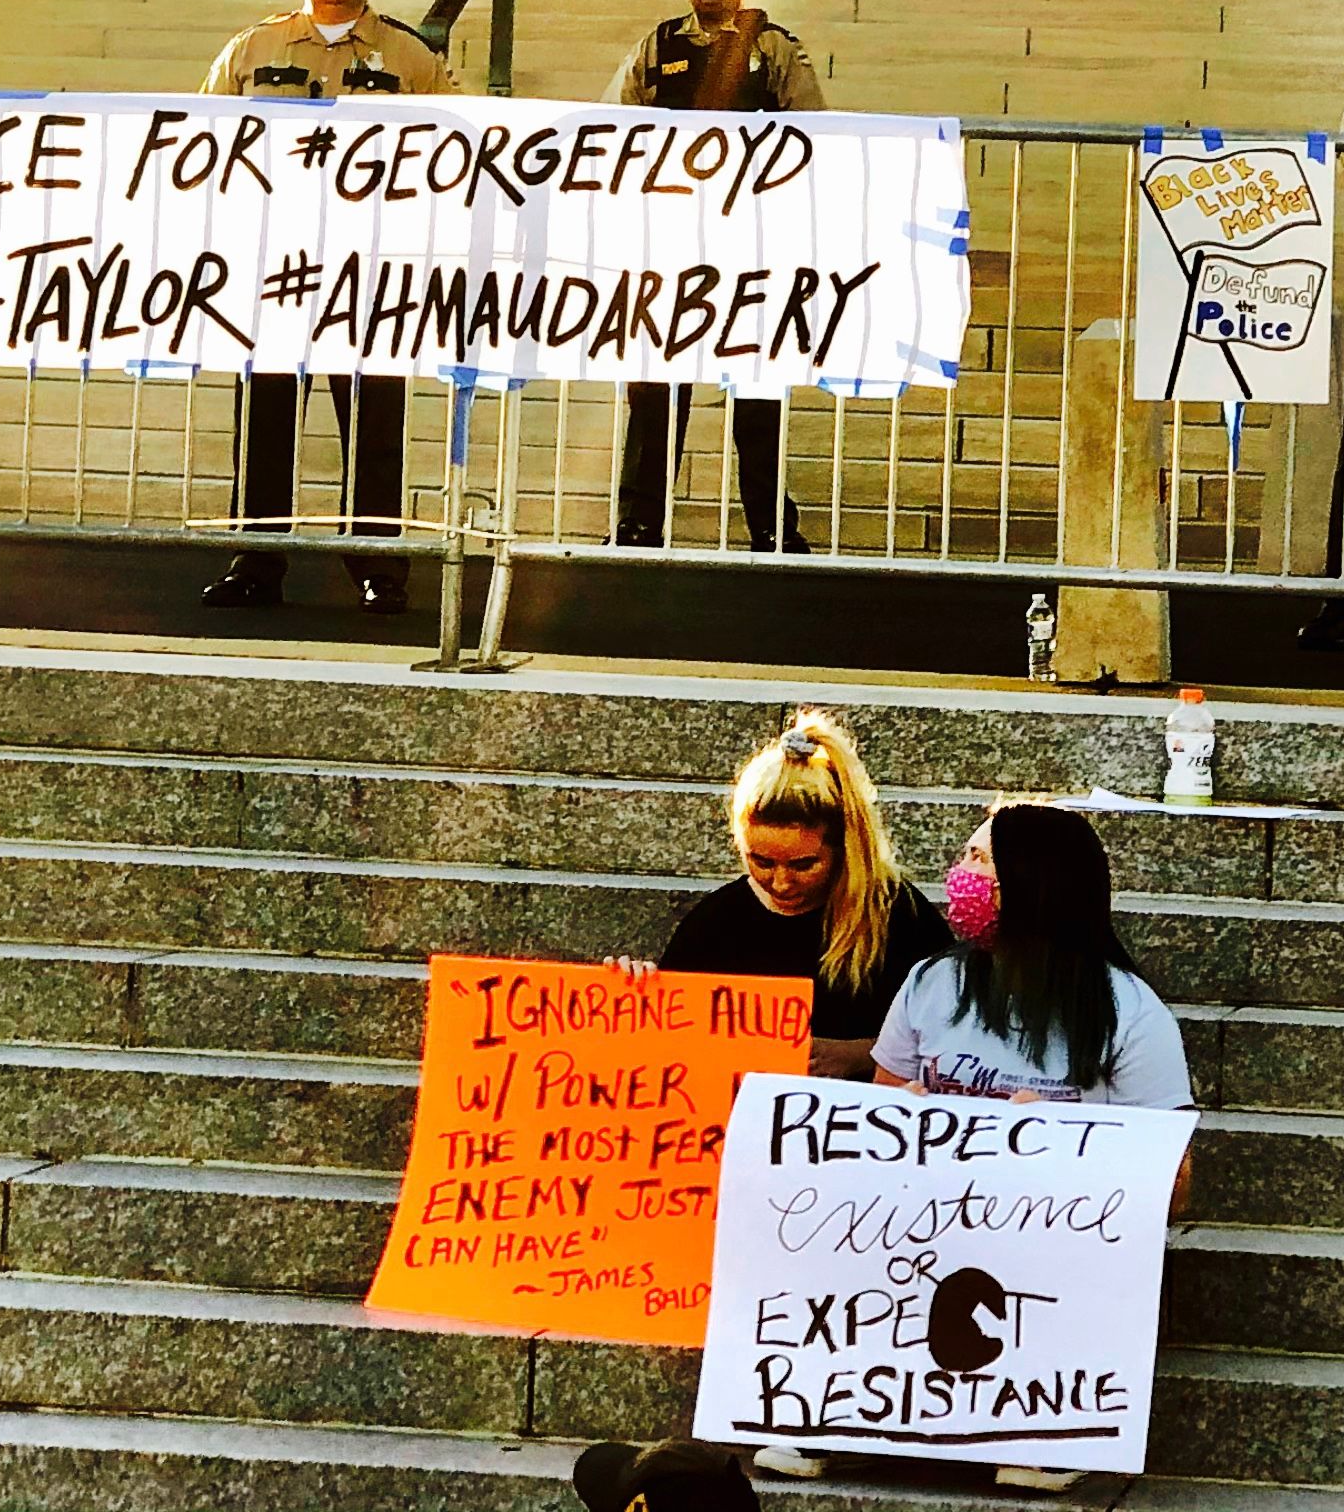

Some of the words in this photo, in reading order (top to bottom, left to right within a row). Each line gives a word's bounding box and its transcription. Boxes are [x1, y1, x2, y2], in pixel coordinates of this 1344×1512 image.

[125, 111, 273, 201] FOR
[286, 122, 813, 217] #GEORGEFLOYD
[1149, 157, 1255, 211] Black
[1195, 169, 1280, 218] Lives
[1219, 184, 1313, 241] Matter
[260, 248, 881, 367] #AHMAUDARBERY
[1202, 264, 1315, 310] Defund
[1235, 299, 1257, 314] the
[1196, 300, 1293, 342] Police
[533, 1049, 698, 1115] POWER
[439, 1129, 517, 1171] THE
[648, 1117, 727, 1172] FER
[769, 1091, 1125, 1167] RESPECT
[421, 1174, 595, 1226] ENEMY
[767, 1178, 1126, 1255] existence
[403, 1233, 482, 1269] CAN
[885, 1249, 944, 1287] OR
[643, 1285, 712, 1317] BALD
[755, 1266, 1060, 1374] EXPECT
[753, 1354, 1129, 1429] RESISTANCE
